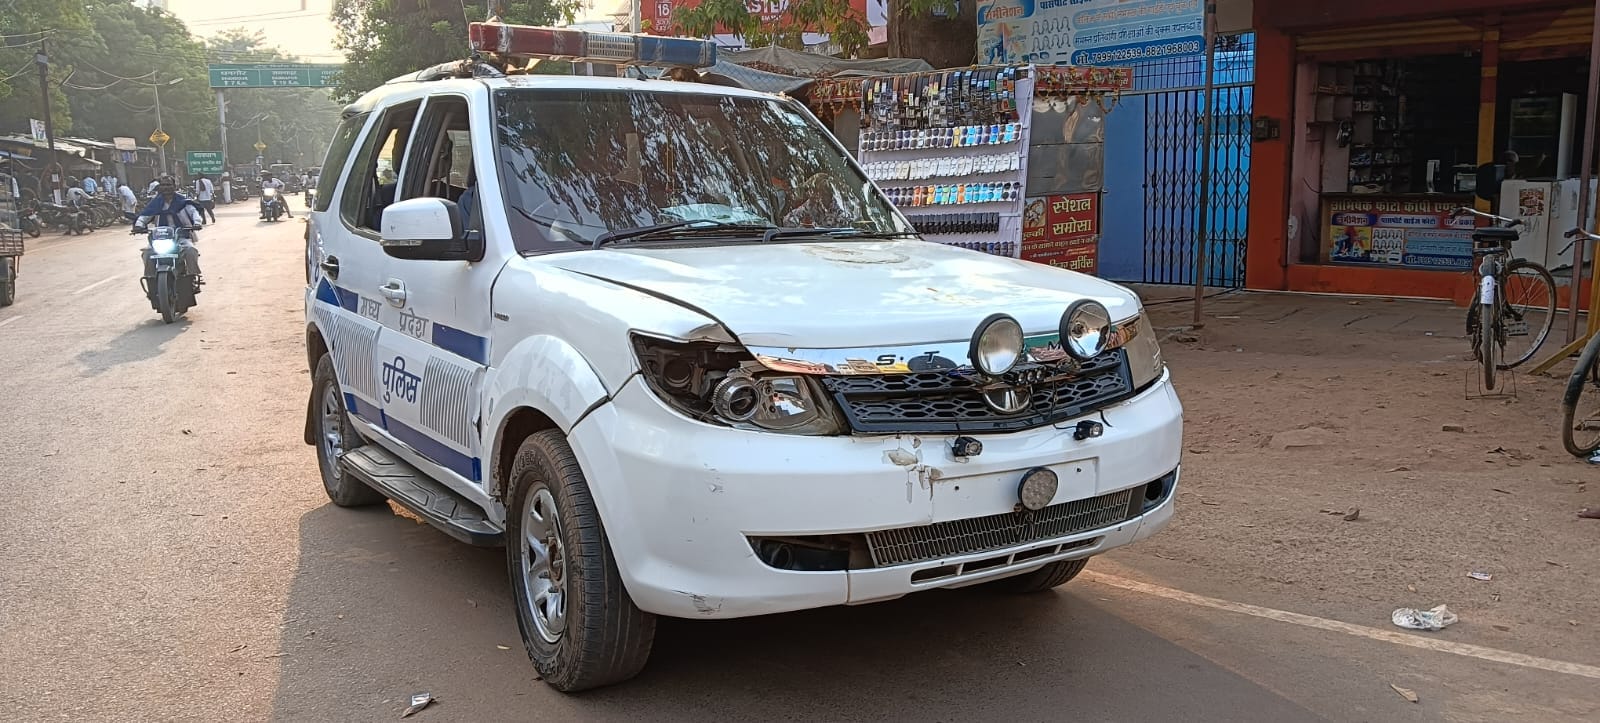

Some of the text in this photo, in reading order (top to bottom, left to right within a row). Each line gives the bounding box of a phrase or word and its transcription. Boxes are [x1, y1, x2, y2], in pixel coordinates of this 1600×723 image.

[1053, 196, 1092, 214] स्पेशल
[1053, 216, 1092, 235] समोसा
[1070, 255, 1094, 270] सर्विस
[360, 296, 429, 339] मध्य प्रदेश
[382, 355, 422, 404] पुलिस
